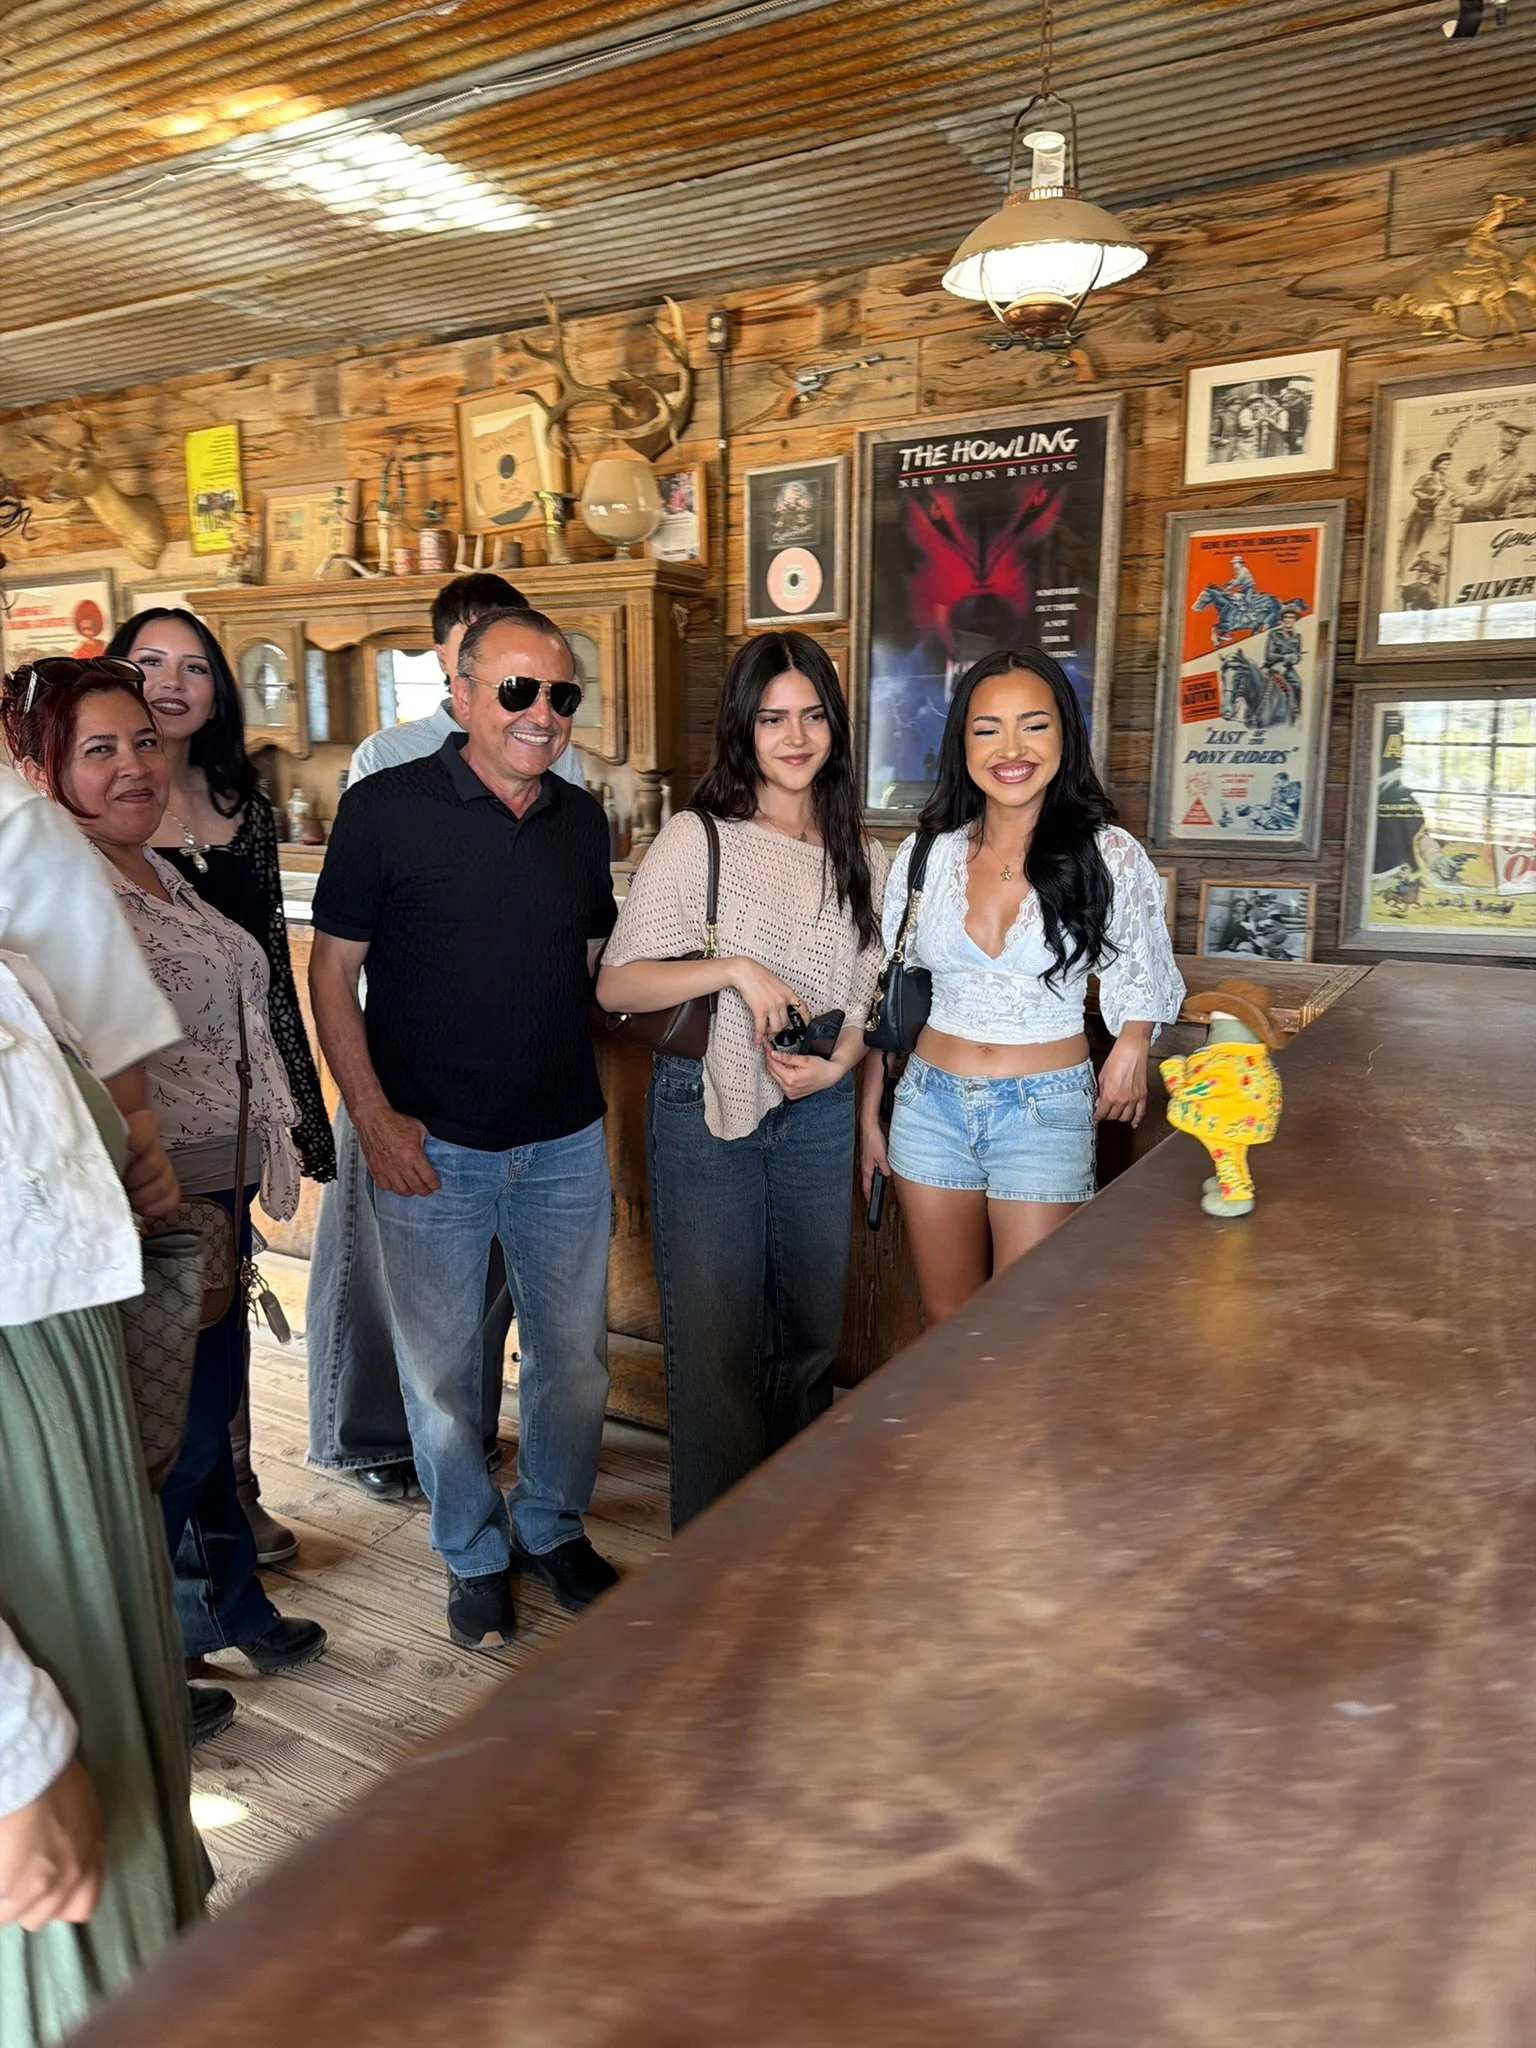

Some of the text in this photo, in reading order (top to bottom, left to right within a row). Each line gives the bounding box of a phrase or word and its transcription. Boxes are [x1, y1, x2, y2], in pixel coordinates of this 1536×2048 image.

[899, 427, 1080, 471] THE HOWLING
[898, 461, 1079, 488] NEW MOON RISING
[1456, 576, 1536, 604] SILVER
[1183, 750, 1229, 764] PONY
